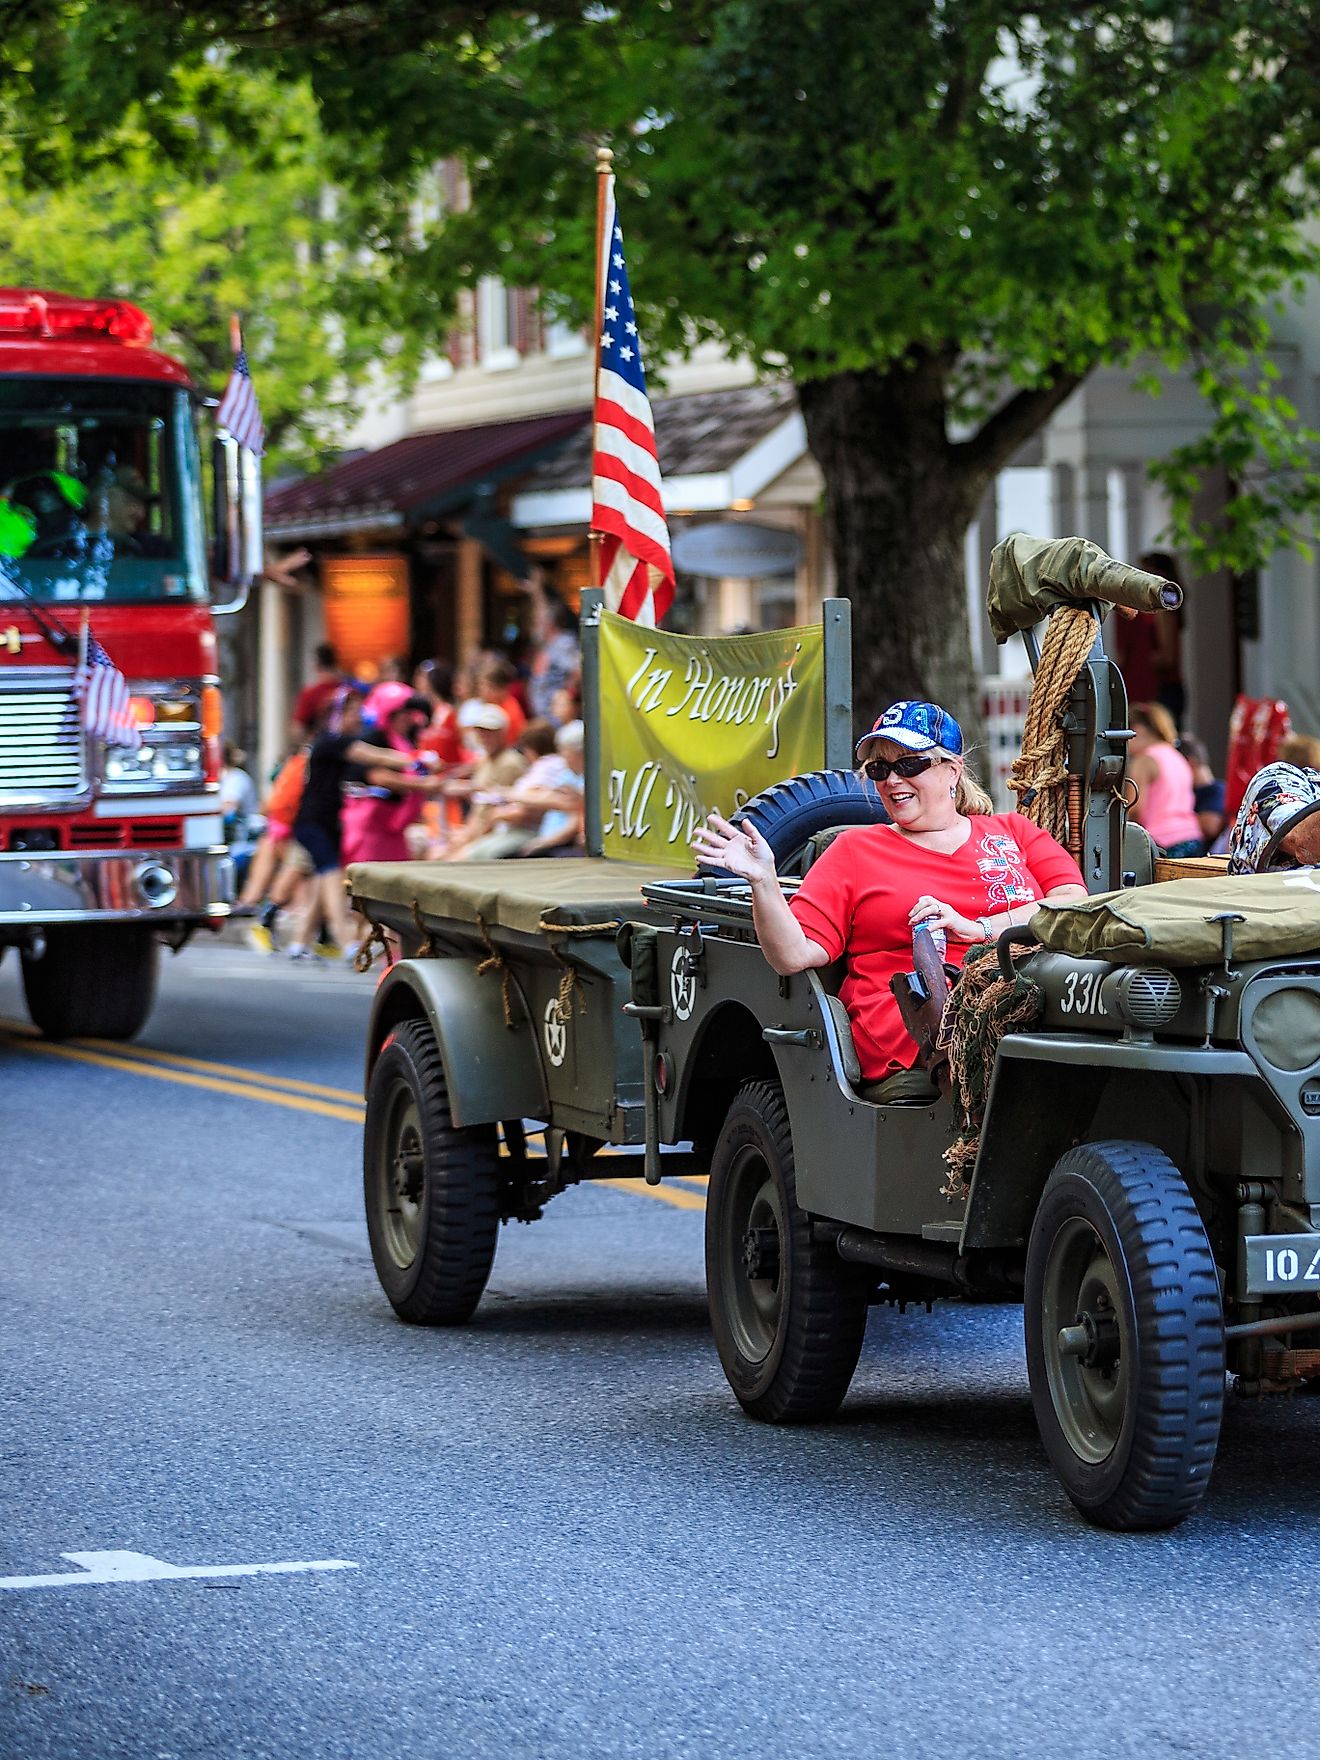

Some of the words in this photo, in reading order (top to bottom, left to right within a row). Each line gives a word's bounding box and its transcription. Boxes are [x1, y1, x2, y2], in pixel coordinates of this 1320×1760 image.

[626, 648, 673, 713] In
[666, 650, 772, 726] Honor
[603, 760, 663, 840] All
[1266, 1249, 1299, 1281] 10
